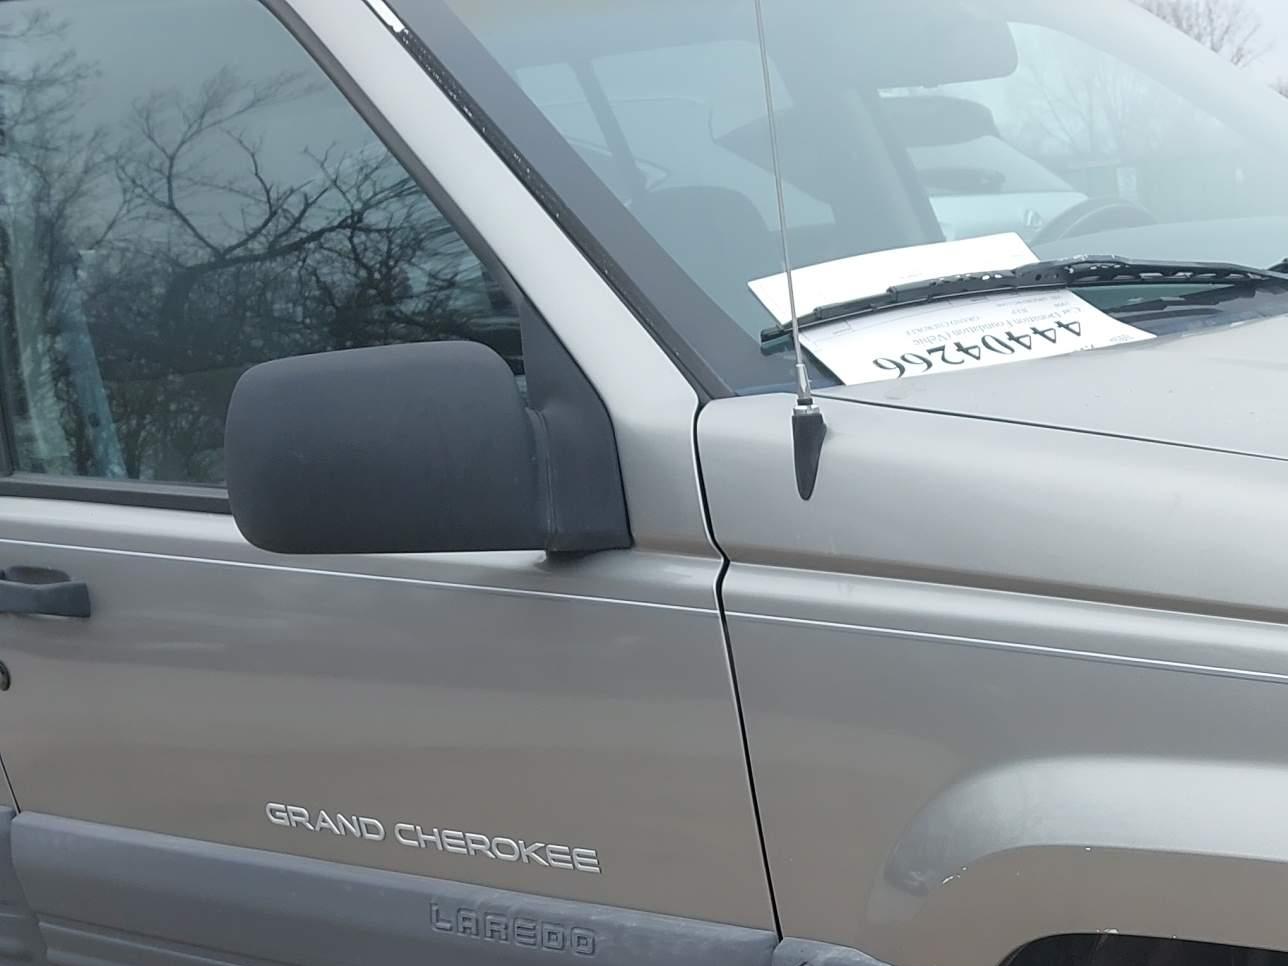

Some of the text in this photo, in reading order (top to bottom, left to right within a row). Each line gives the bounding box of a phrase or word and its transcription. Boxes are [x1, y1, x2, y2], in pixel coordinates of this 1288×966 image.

[872, 319, 1083, 379] 44404266
[265, 801, 602, 874] GRAND CHEROKEE
[429, 902, 597, 956] LAREDO
